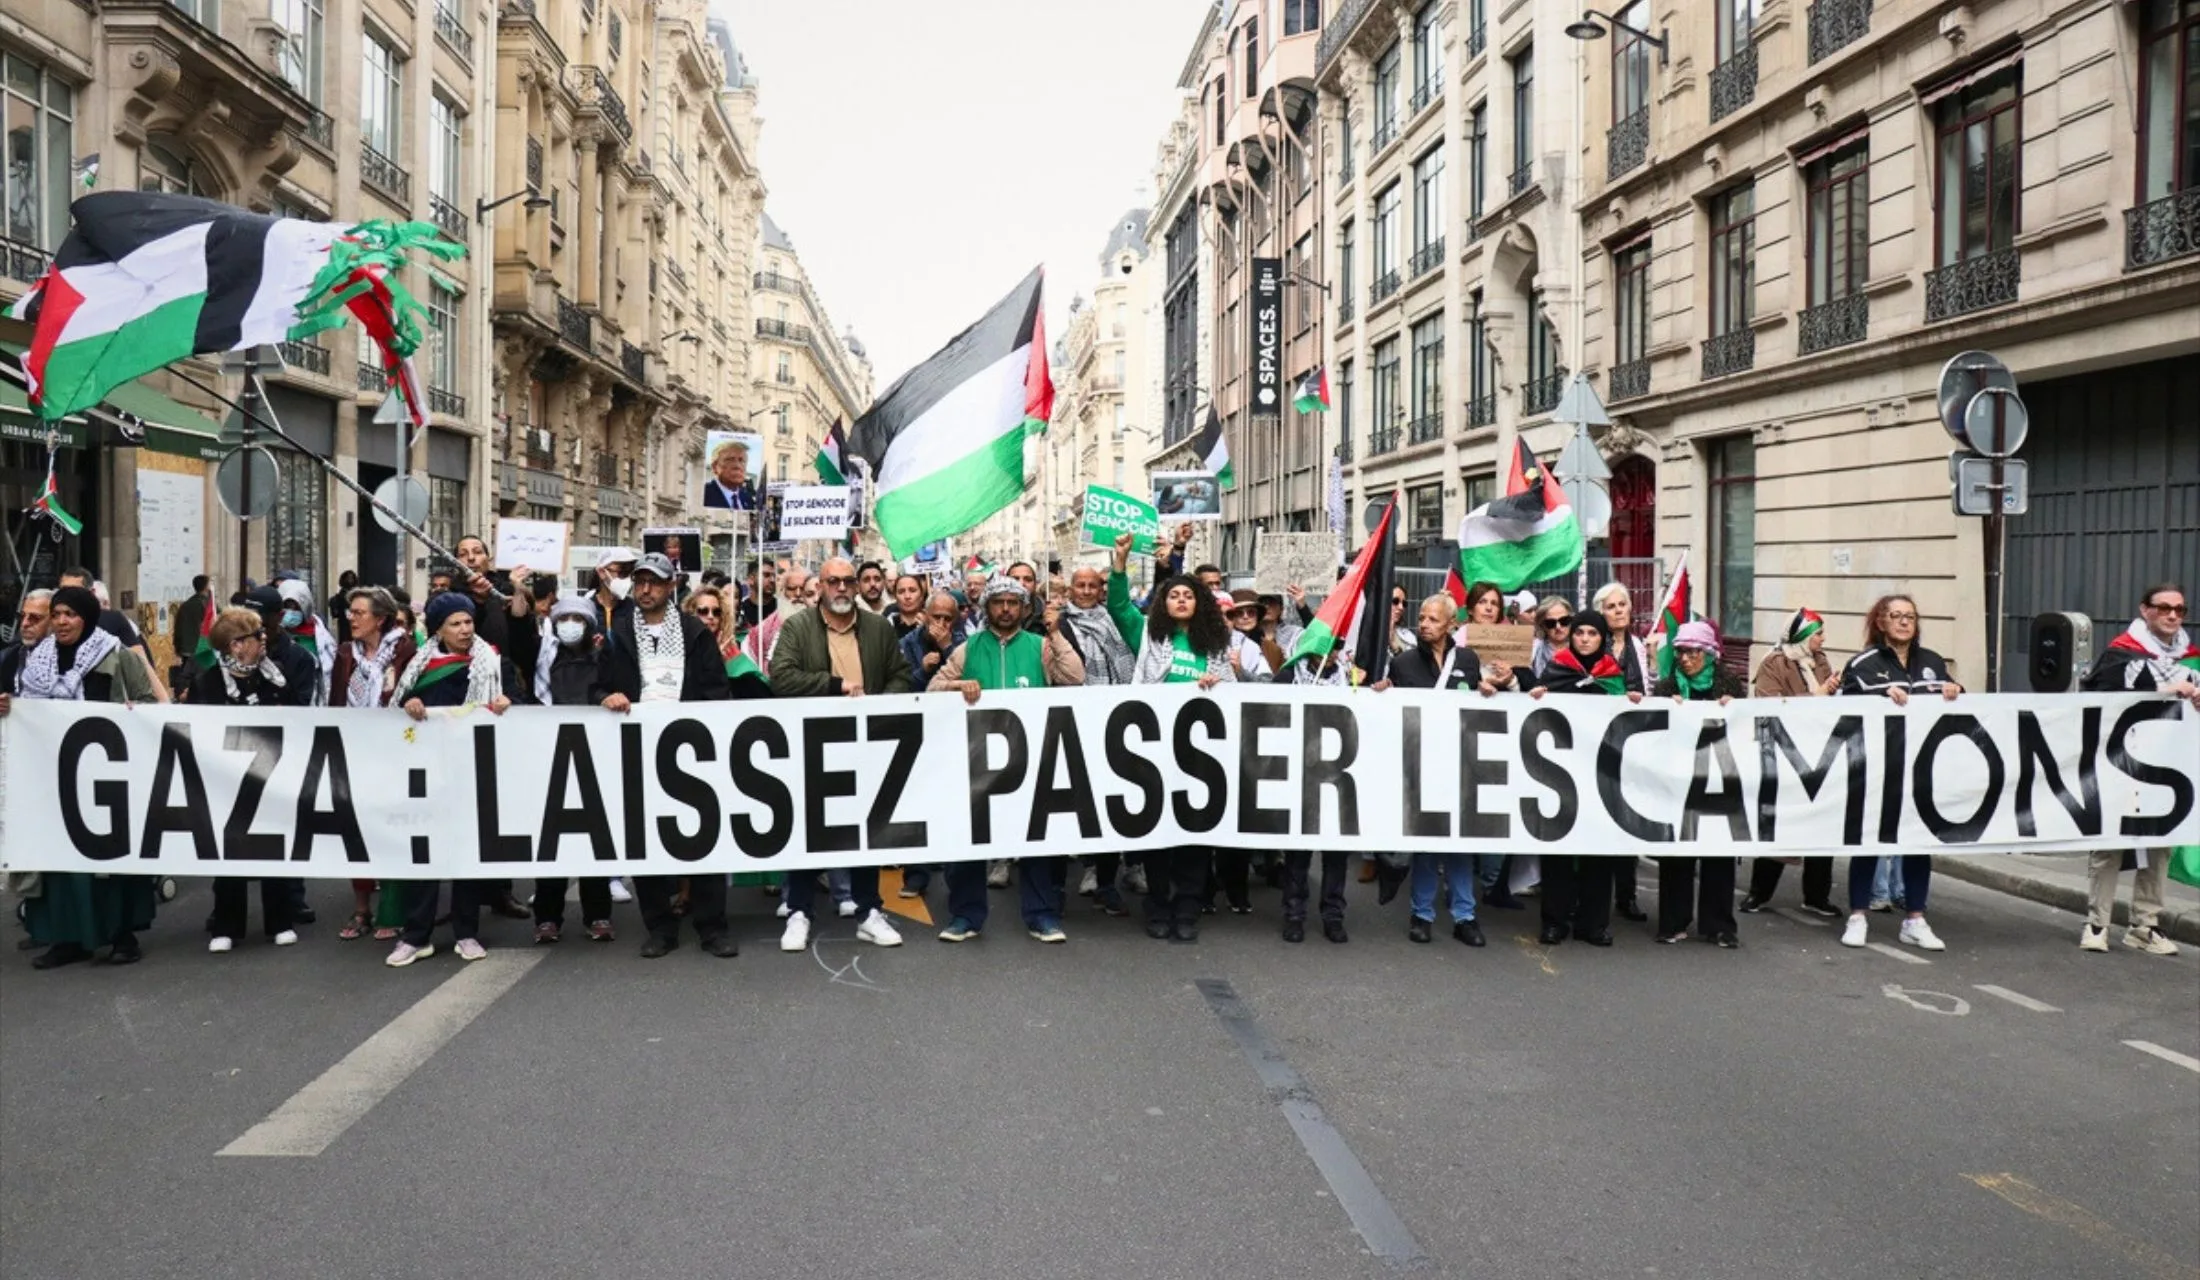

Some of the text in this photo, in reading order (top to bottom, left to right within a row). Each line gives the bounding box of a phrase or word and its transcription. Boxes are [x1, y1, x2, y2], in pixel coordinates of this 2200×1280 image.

[1, 424, 30, 437] URBAN
[786, 500, 804, 509] STOP
[1087, 493, 1142, 519] STOP
[784, 516, 792, 527] LE
[794, 515, 824, 525] SILENCE
[827, 514, 840, 525] TUE
[57, 697, 2195, 864] GAZA : LAISSEZ PASSER LES CAMIONS
